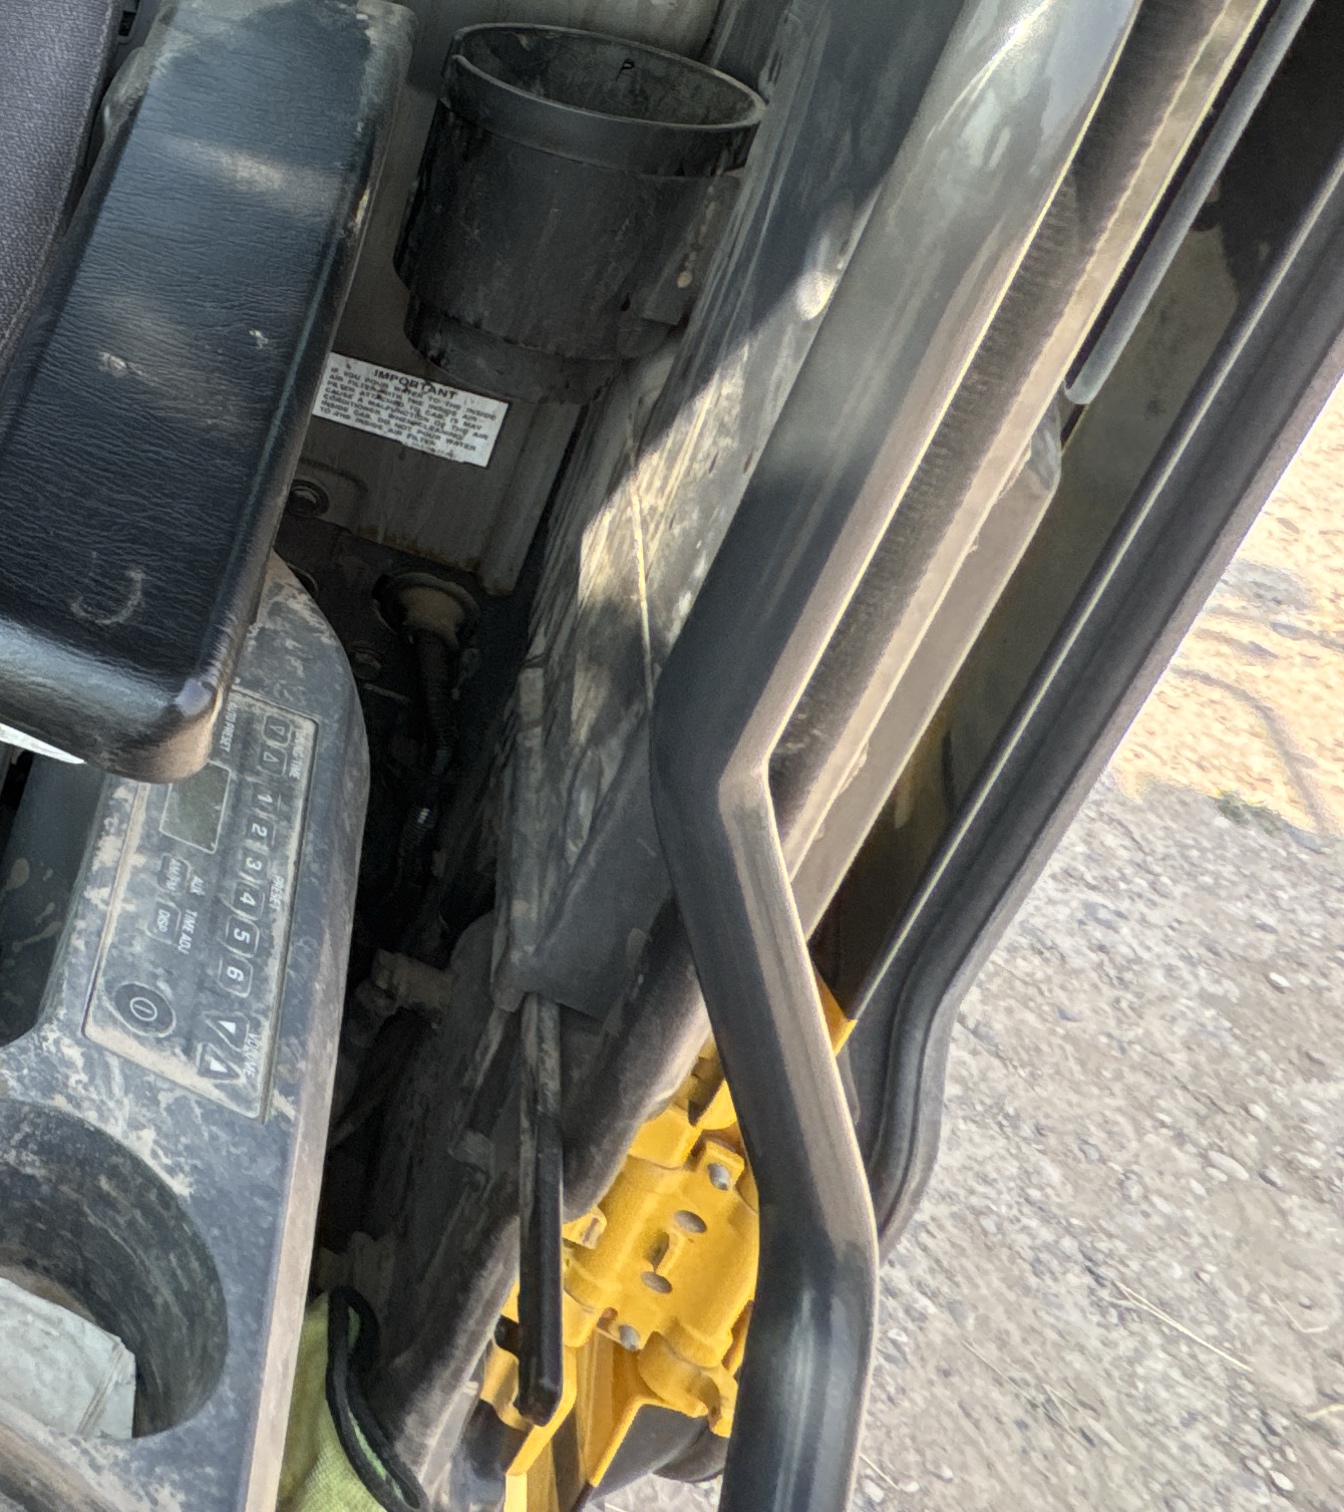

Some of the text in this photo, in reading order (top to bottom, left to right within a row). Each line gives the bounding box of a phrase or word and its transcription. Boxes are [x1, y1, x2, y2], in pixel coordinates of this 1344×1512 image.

[374, 369, 458, 399] IMPORTANT
[219, 723, 236, 752] PRESET
[257, 793, 273, 804] 1
[251, 823, 267, 837] 2
[245, 857, 262, 871] 3
[239, 892, 256, 906] 4
[269, 875, 284, 911] PRESET
[157, 909, 170, 932] DISP
[178, 909, 198, 955] TIME ADJ
[233, 928, 251, 943] 5
[226, 966, 244, 982] 6
[243, 1032, 261, 1078] VOLUME
